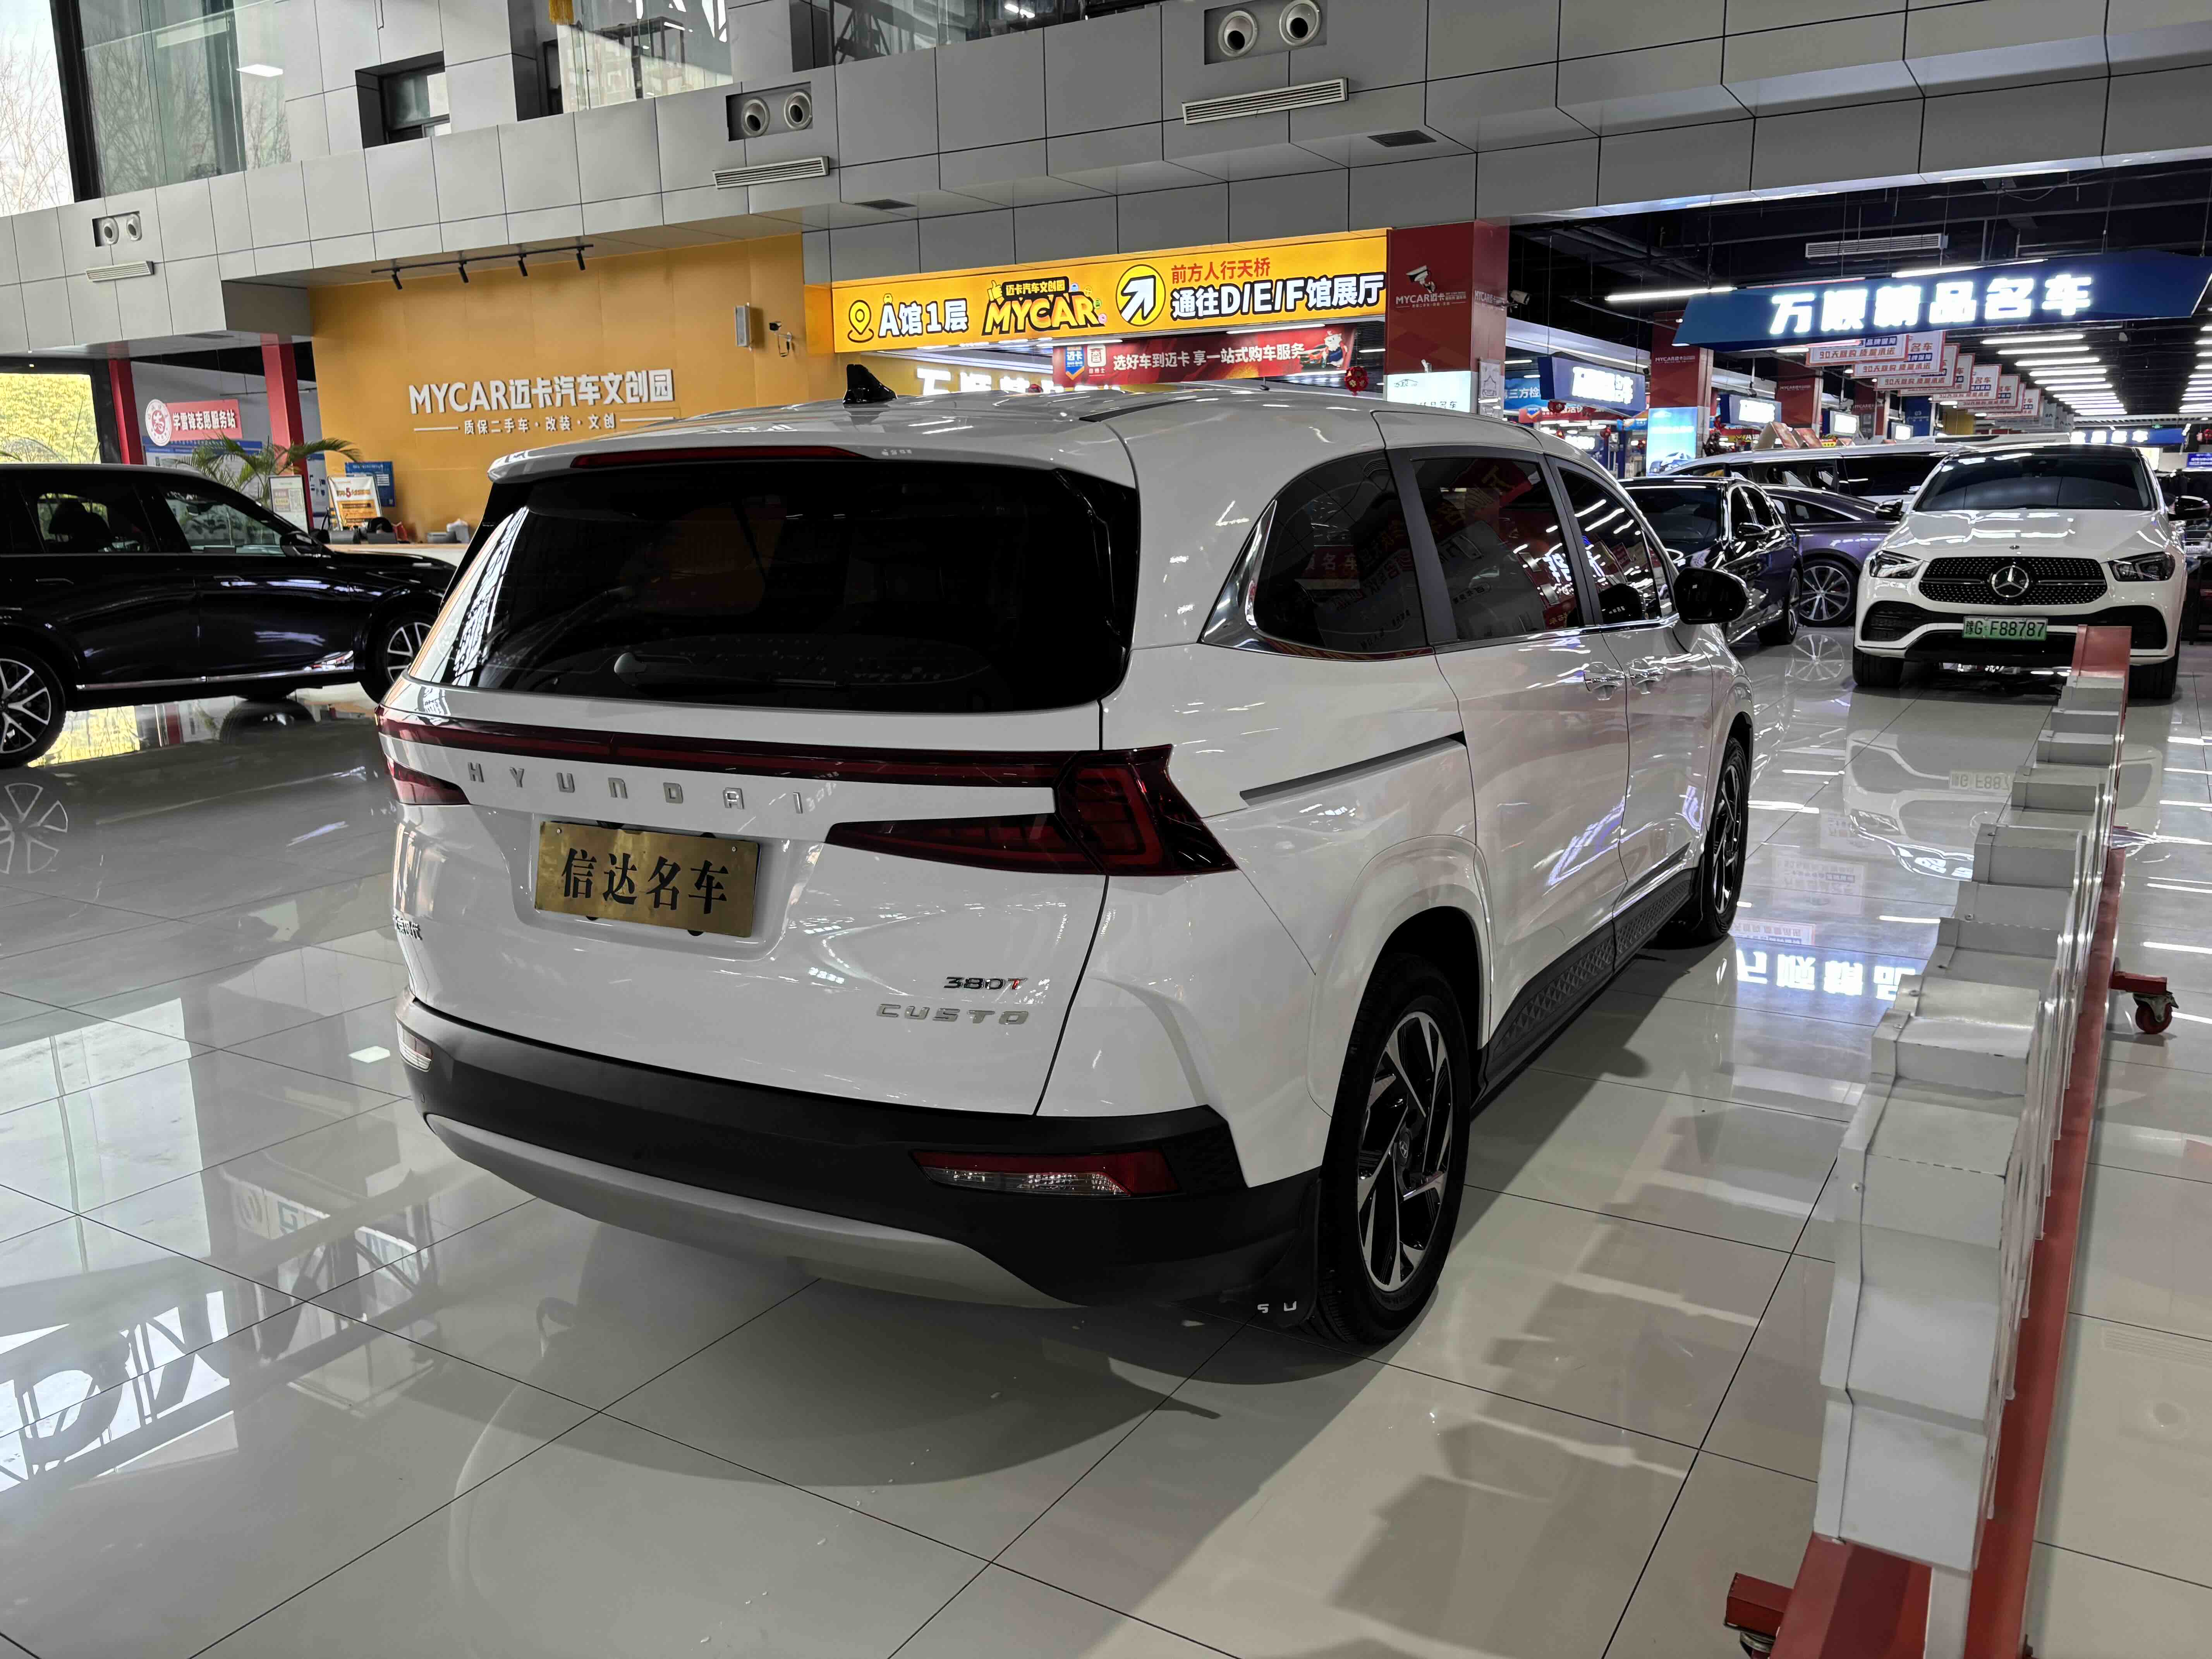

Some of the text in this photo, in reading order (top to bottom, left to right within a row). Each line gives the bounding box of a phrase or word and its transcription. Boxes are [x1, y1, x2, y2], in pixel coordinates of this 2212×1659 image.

[1171, 257, 1270, 284] 前方人行天桥
[1006, 280, 1065, 296] 迈卡汽车文创园
[1172, 274, 1385, 319] 通往D/E/F馆展厅
[879, 299, 969, 337] A馆1层
[983, 294, 1104, 335] MYCAR
[1113, 343, 1305, 371] 选好车到迈卡 享一站式购车服务
[1911, 342, 1932, 352] 名车
[409, 369, 674, 414] MYCAR迈卡汽车文创园
[173, 409, 236, 431] 学雷锋志愿服务站
[464, 413, 616, 435] 质保二手车·改装·文创
[467, 761, 804, 814] HYUNDAI
[562, 848, 729, 915] 信达名车
[943, 976, 1028, 990] 380T
[876, 1003, 1029, 1025] CUSTO
